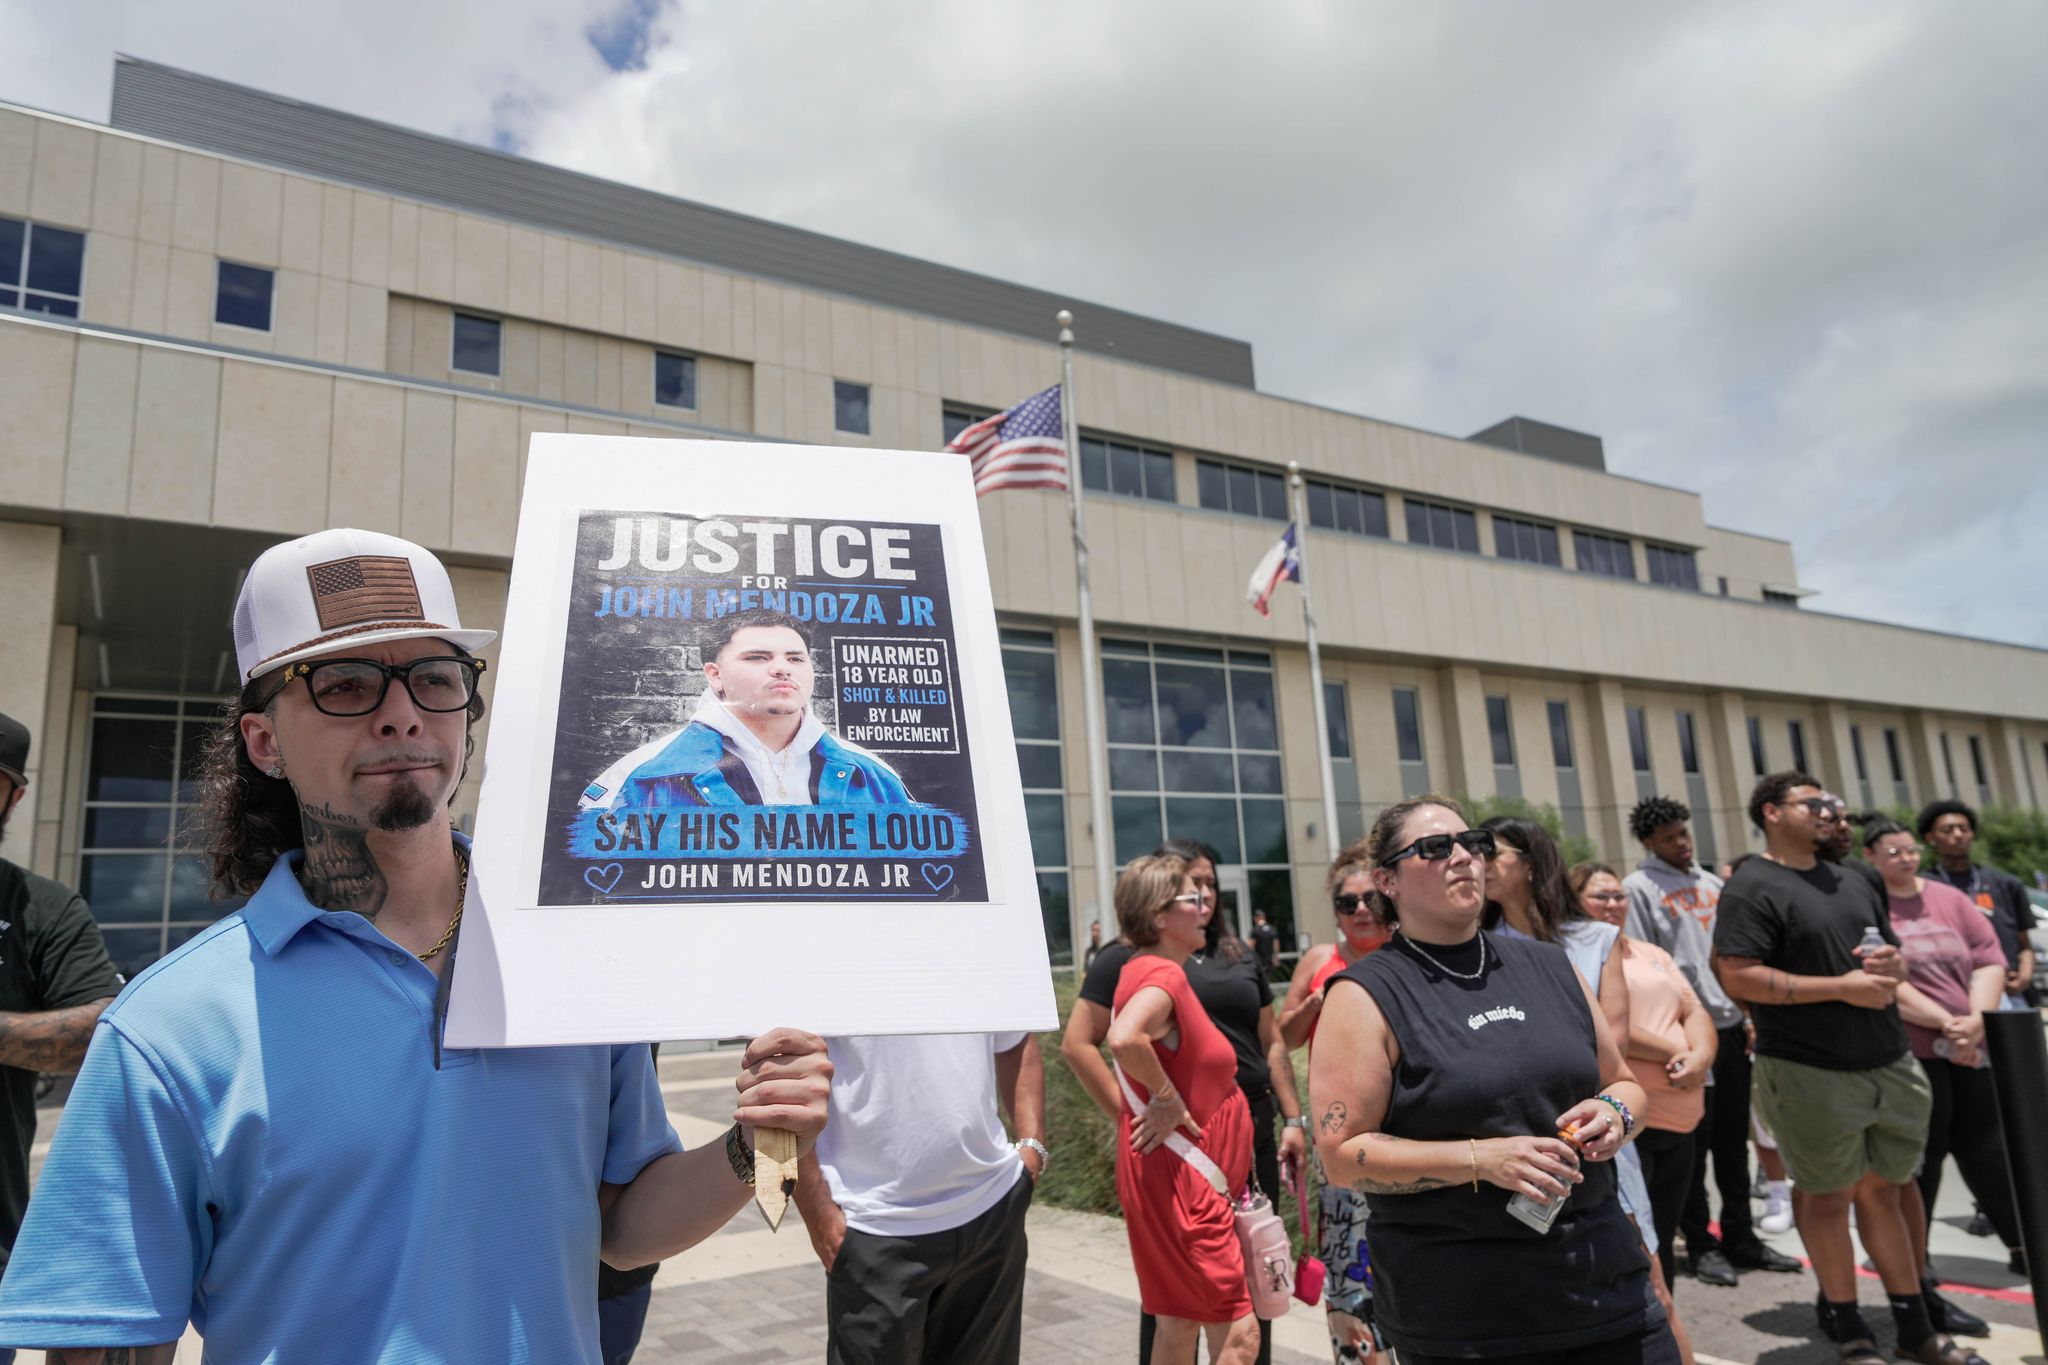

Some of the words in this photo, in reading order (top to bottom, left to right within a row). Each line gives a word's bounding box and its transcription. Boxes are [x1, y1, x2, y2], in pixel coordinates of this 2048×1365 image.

[598, 518, 917, 581] JUSTICE
[741, 575, 788, 590] FOR
[594, 584, 693, 619] JOHN
[705, 587, 887, 625] MENDOZA
[897, 595, 937, 627] JR
[841, 644, 940, 667] UNARMED
[841, 666, 863, 684] 18
[867, 667, 910, 684] YEAR
[912, 668, 943, 685] OLD
[842, 686, 881, 703] SHOT
[885, 687, 896, 704] &
[900, 688, 947, 705] KILLED
[868, 707, 887, 723] BY
[891, 708, 922, 724] LAW
[847, 725, 950, 743] ENFORCEMENT
[594, 813, 668, 852] SAY
[679, 813, 740, 851] HIS
[754, 813, 857, 851] NAME
[867, 813, 955, 851] LOUD
[641, 864, 719, 889] JOHN
[732, 863, 870, 888] MENDOZA
[880, 864, 911, 888] JR
[1662, 886, 1719, 920] TEXA
[1484, 1005, 1526, 1022] miedo
